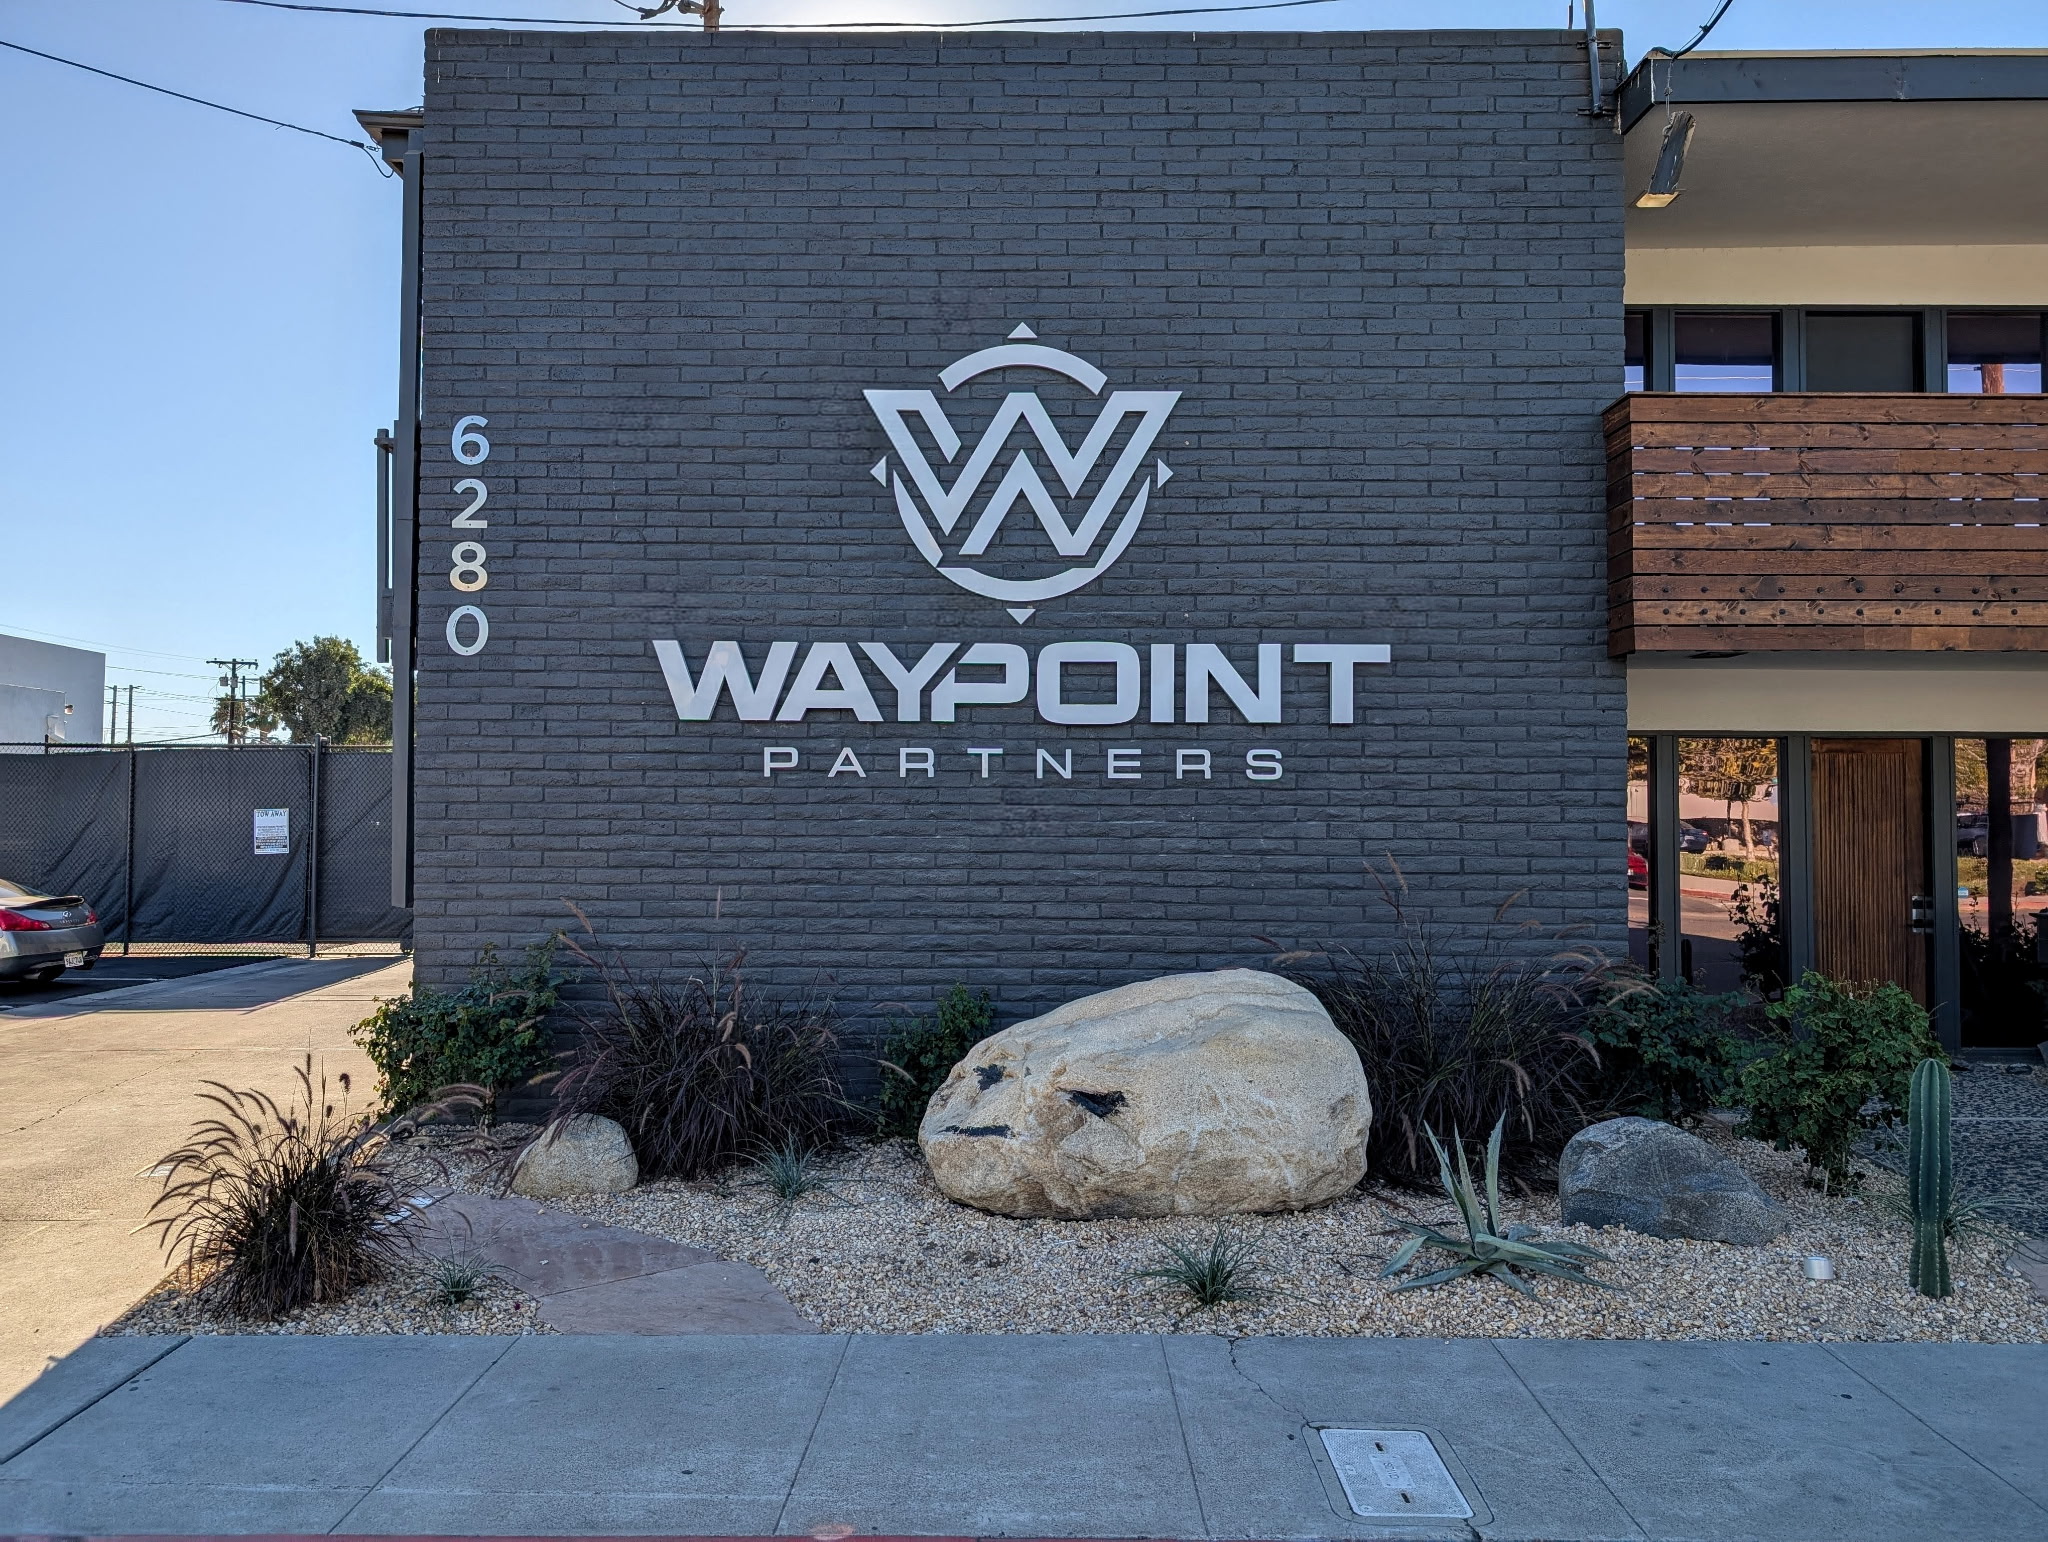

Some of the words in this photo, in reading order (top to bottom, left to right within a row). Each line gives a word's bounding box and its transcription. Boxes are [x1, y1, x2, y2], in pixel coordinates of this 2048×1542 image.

[446, 415, 490, 656] 6280
[652, 639, 1391, 725] WAYPOINT
[763, 746, 1284, 781] PARTNERS
